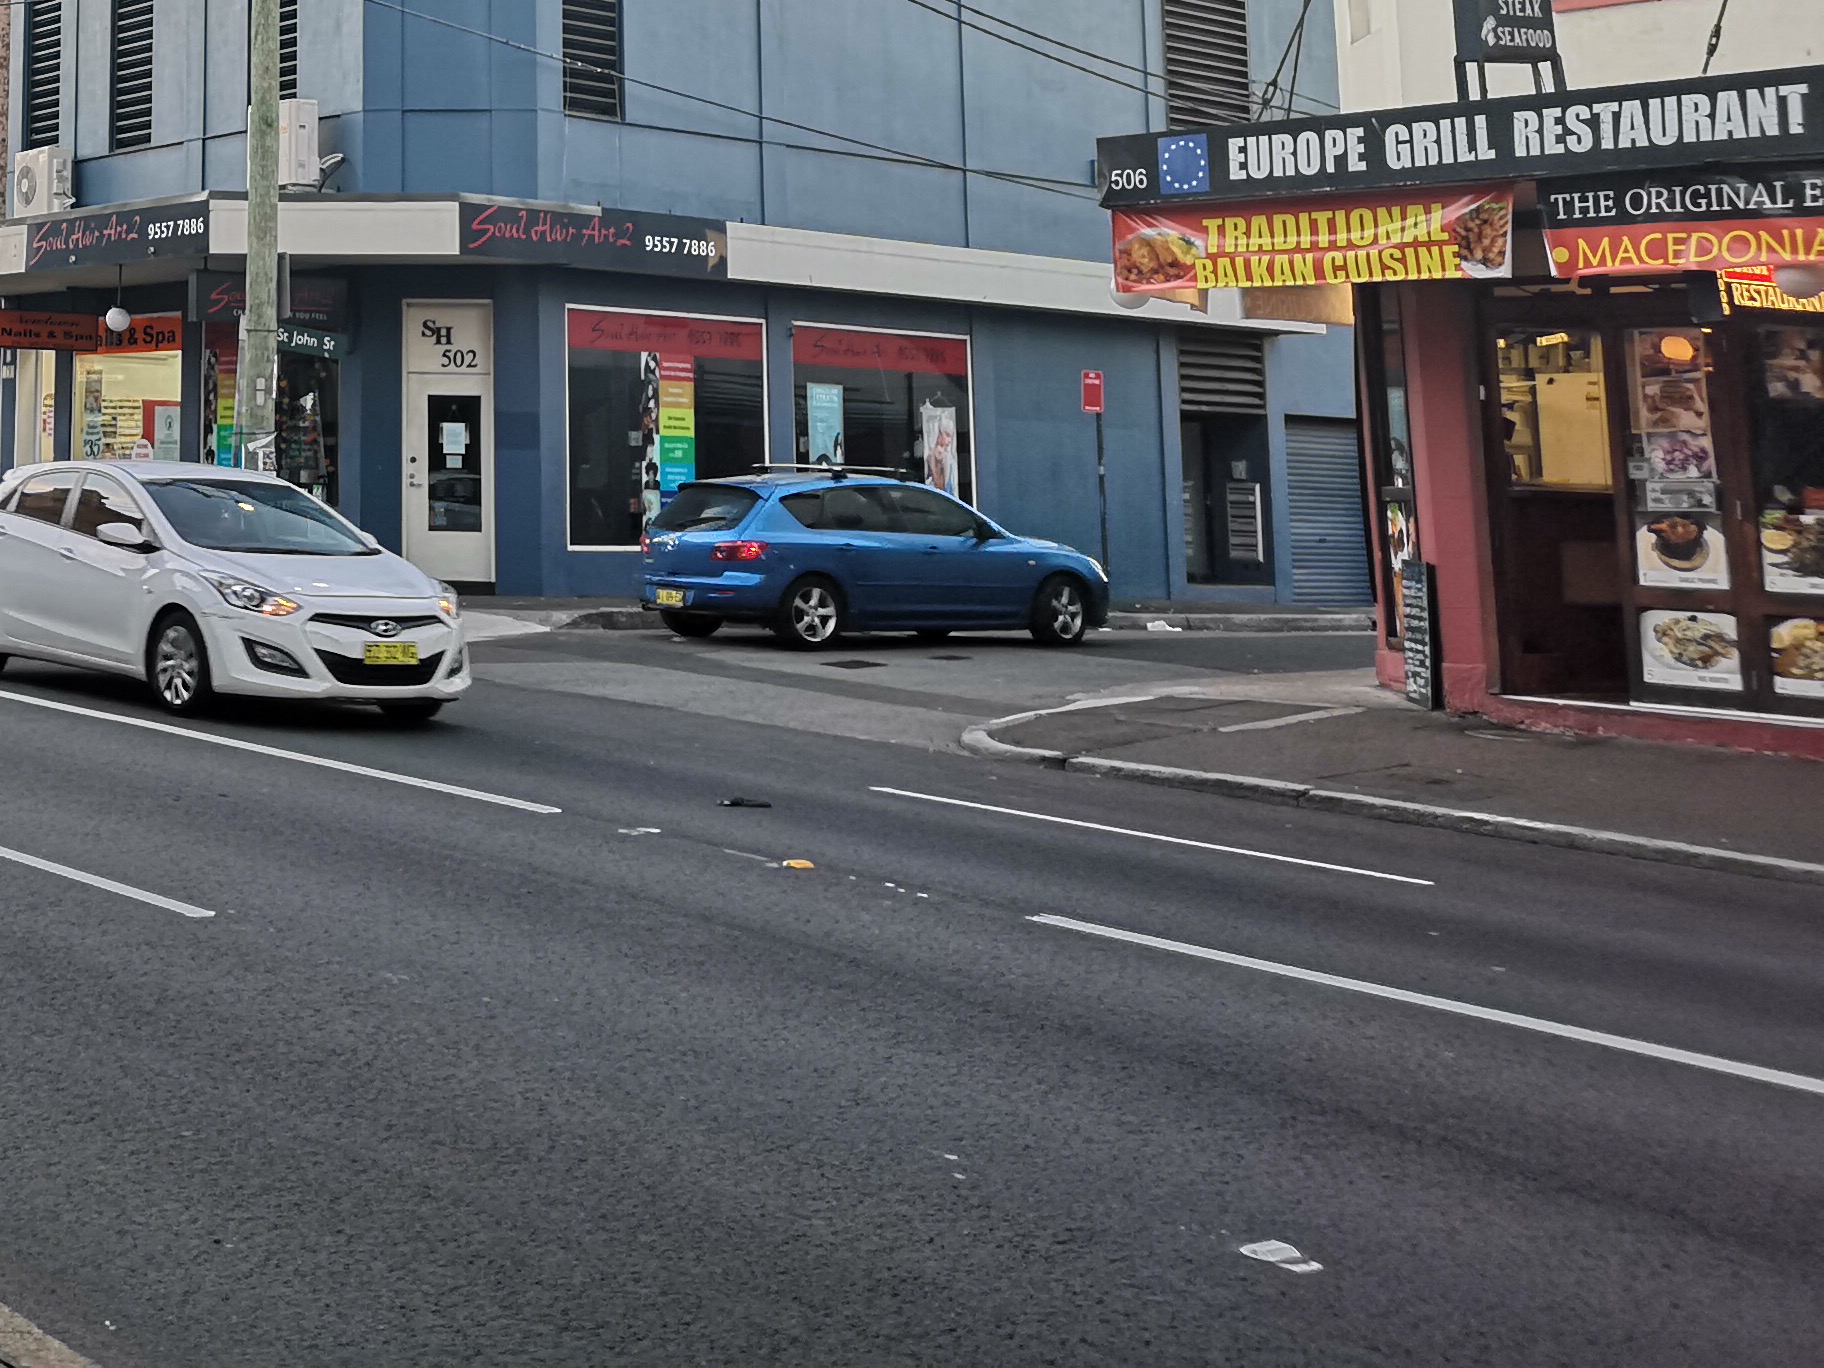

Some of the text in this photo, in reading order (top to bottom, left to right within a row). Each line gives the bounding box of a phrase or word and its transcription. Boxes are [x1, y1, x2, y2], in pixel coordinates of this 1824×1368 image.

[1496, 26, 1553, 48] SEAFOOD
[1111, 83, 1810, 190] 506 EUROPE GRILL RESTAURANT
[1550, 190, 1616, 220] THE
[1625, 181, 1794, 215] ORIGINAL
[148, 221, 174, 240] 9557
[177, 217, 204, 236] 7886
[468, 205, 527, 249] Soul
[531, 211, 576, 244] Hair
[645, 234, 678, 254] 9557
[682, 238, 717, 257] 7886
[1202, 202, 1449, 254] TRADITIONAL
[1194, 244, 1463, 290] BALKAN CUISINE
[126, 328, 138, 347] &
[142, 324, 176, 349] Spa
[277, 327, 336, 351] St John St
[441, 349, 478, 369] 502
